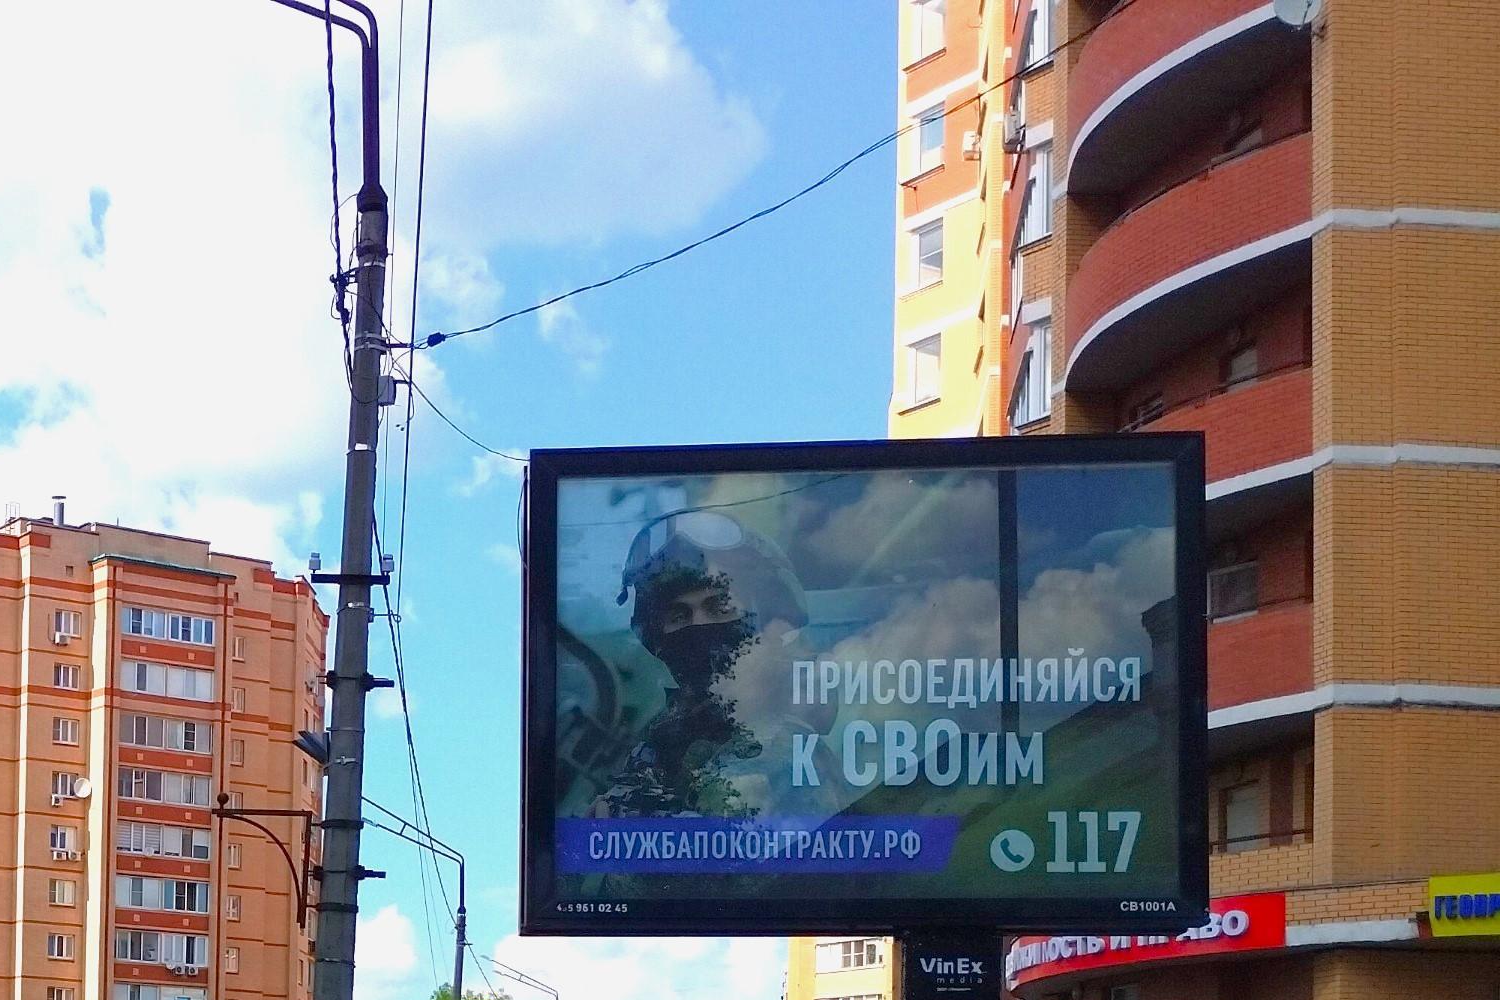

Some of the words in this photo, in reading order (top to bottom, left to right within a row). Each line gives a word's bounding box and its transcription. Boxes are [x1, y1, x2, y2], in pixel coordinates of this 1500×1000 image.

[792, 648, 1141, 709] ПРИСОЕДИНЯЙСЯ
[589, 829, 922, 860] СЛУЖБАПОКОНТРАКТУ.РФ
[1046, 811, 1142, 874] 117
[598, 903, 612, 912] 02
[614, 903, 628, 912] 45
[936, 976, 983, 984] media
